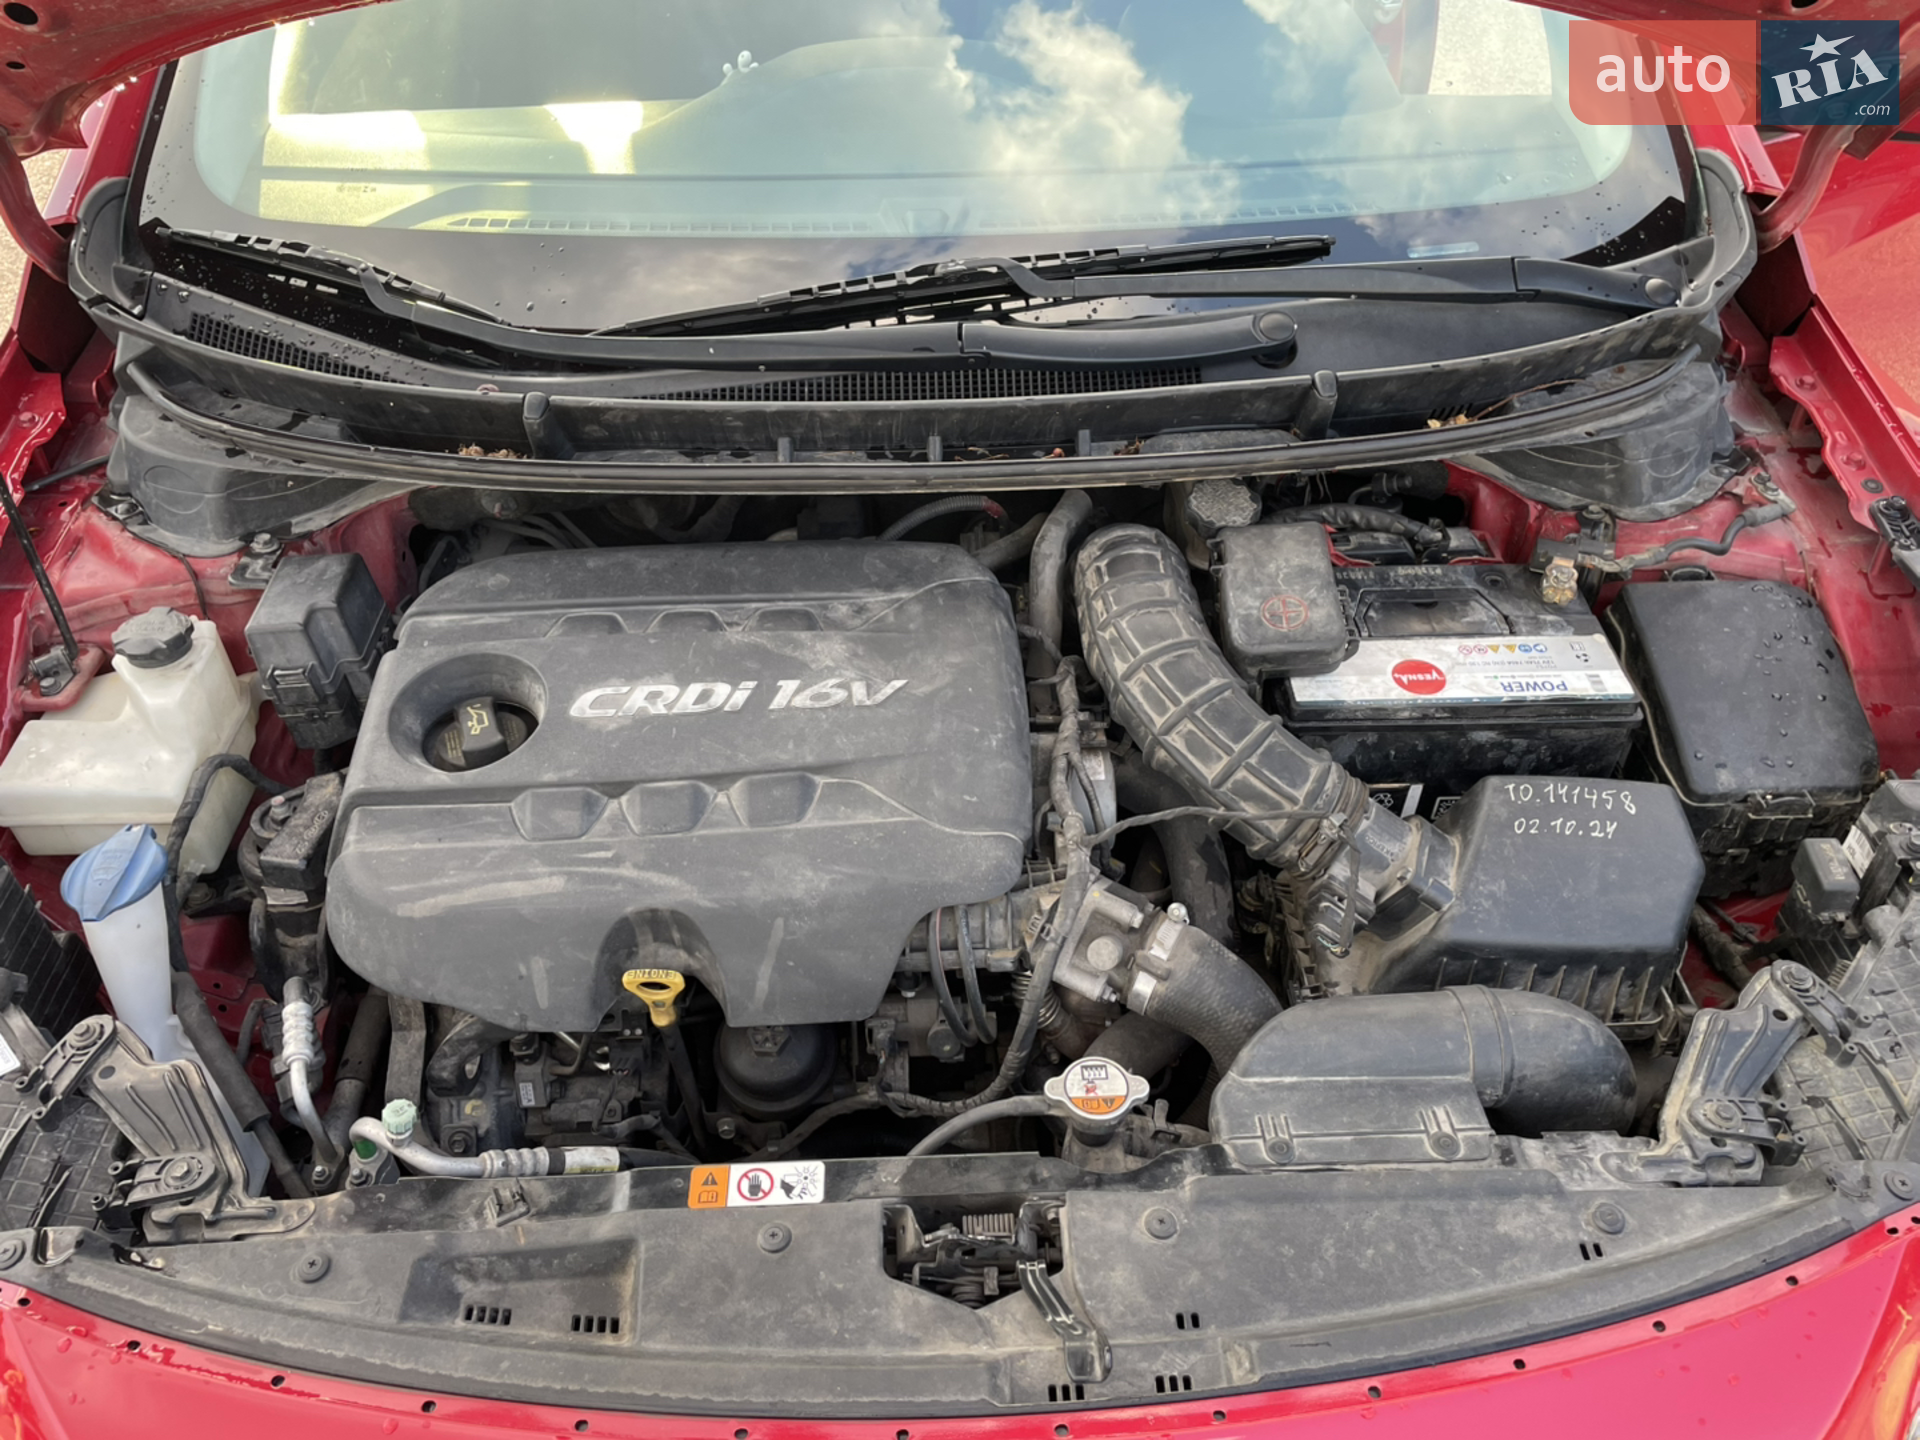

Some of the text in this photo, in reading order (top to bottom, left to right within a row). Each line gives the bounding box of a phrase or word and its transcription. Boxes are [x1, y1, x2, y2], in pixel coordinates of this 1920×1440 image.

[569, 677, 909, 718] CRDi 16V
[1500, 680, 1568, 693] POWER
